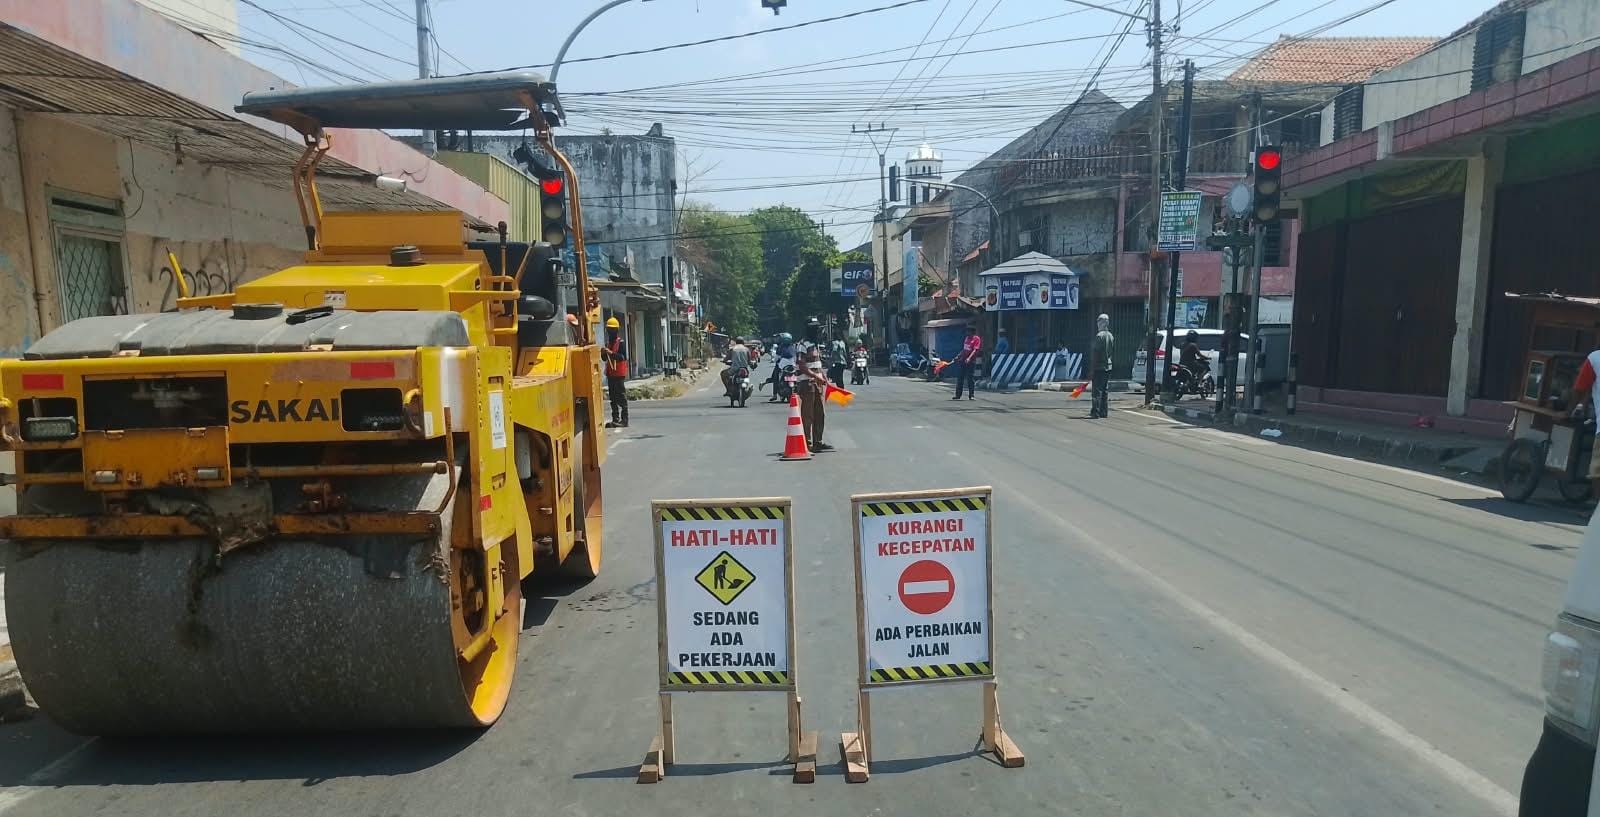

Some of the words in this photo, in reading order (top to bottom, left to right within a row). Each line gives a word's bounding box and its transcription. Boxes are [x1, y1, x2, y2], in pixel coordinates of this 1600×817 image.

[230, 399, 340, 424] SAKAI
[888, 518, 963, 536] KURANGI
[671, 528, 777, 547] HATI-HATI
[878, 537, 975, 556] KECEPATAN
[693, 611, 759, 626] SEDANG
[710, 631, 744, 646] ADA
[875, 627, 902, 642] ADA
[905, 621, 982, 639] PERBAIKAN
[679, 652, 776, 667] PEKERJAAN
[908, 642, 950, 659] JALAN
